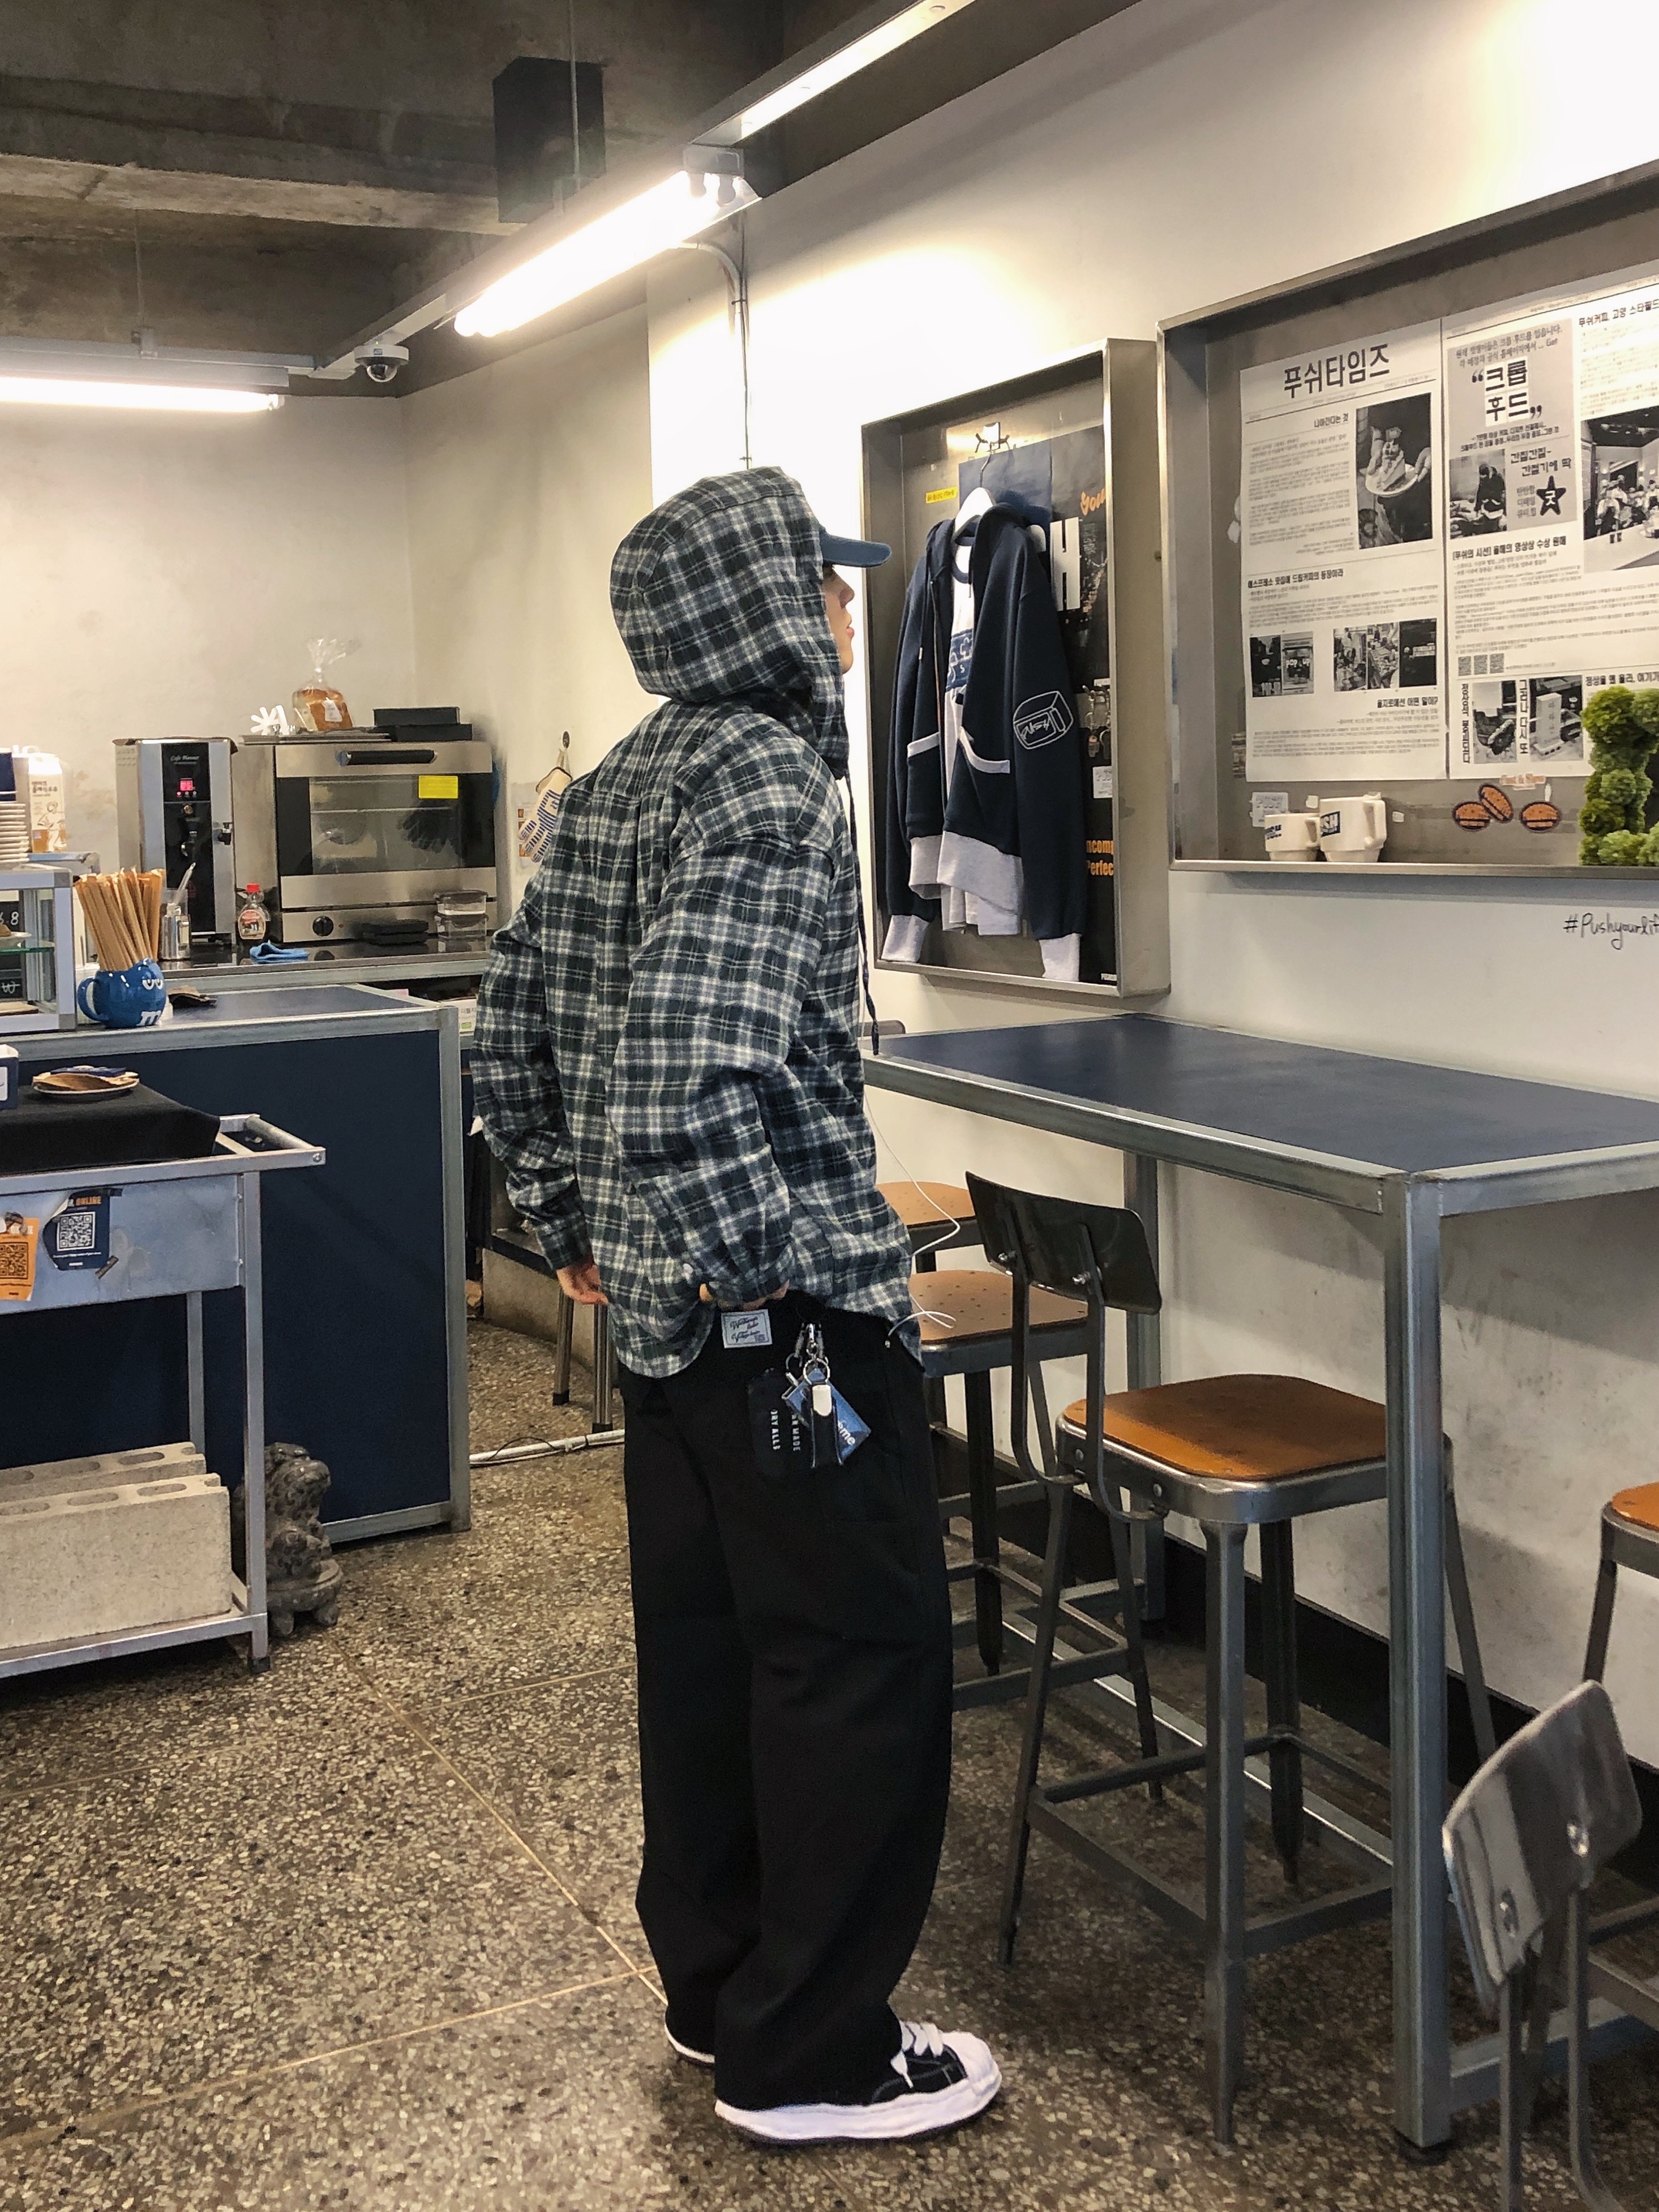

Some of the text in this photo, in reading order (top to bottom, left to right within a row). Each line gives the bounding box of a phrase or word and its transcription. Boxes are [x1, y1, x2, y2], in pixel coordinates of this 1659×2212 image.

[1284, 343, 1390, 399] 푸쉬타임즈
[1545, 490, 1556, 506] 굿
[1537, 538, 1550, 549] 수상
[1519, 743, 1528, 754] 또
